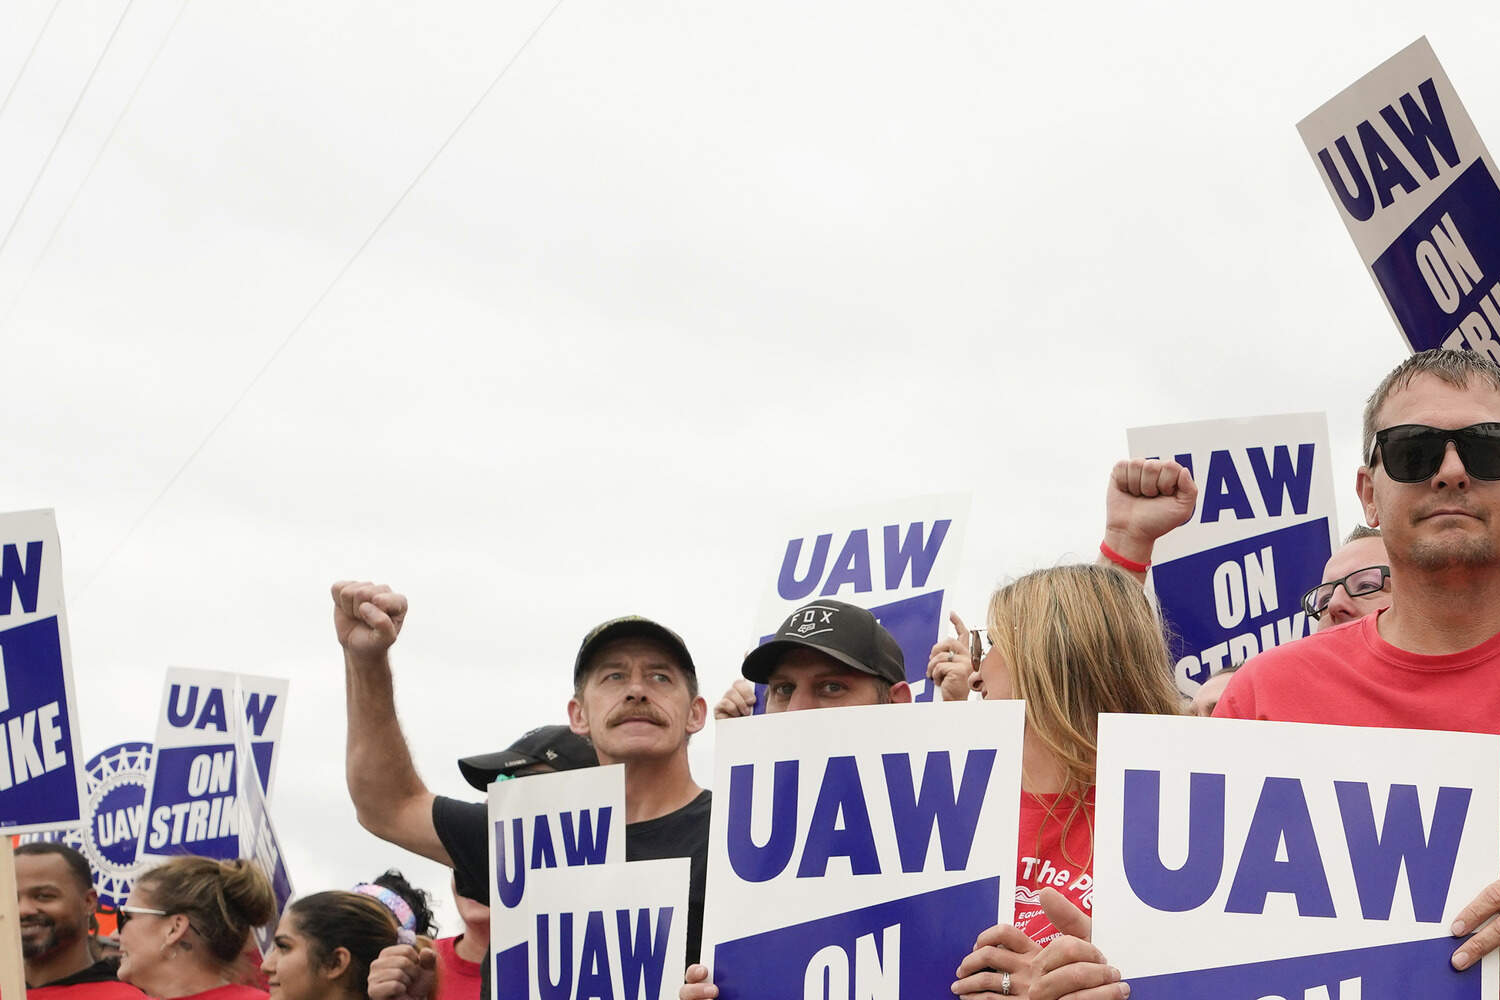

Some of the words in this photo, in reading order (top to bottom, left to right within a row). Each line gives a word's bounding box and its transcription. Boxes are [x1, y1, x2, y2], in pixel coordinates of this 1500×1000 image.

[1317, 77, 1461, 222] UAW
[1415, 211, 1485, 314] ON
[777, 518, 953, 601] UAW
[1212, 545, 1279, 629] ON
[789, 609, 834, 628] FOX
[187, 750, 235, 798] ON
[727, 749, 998, 883] UAW
[495, 806, 613, 908] UAW
[1020, 856, 1071, 887] The
[1121, 768, 1473, 924] UAW
